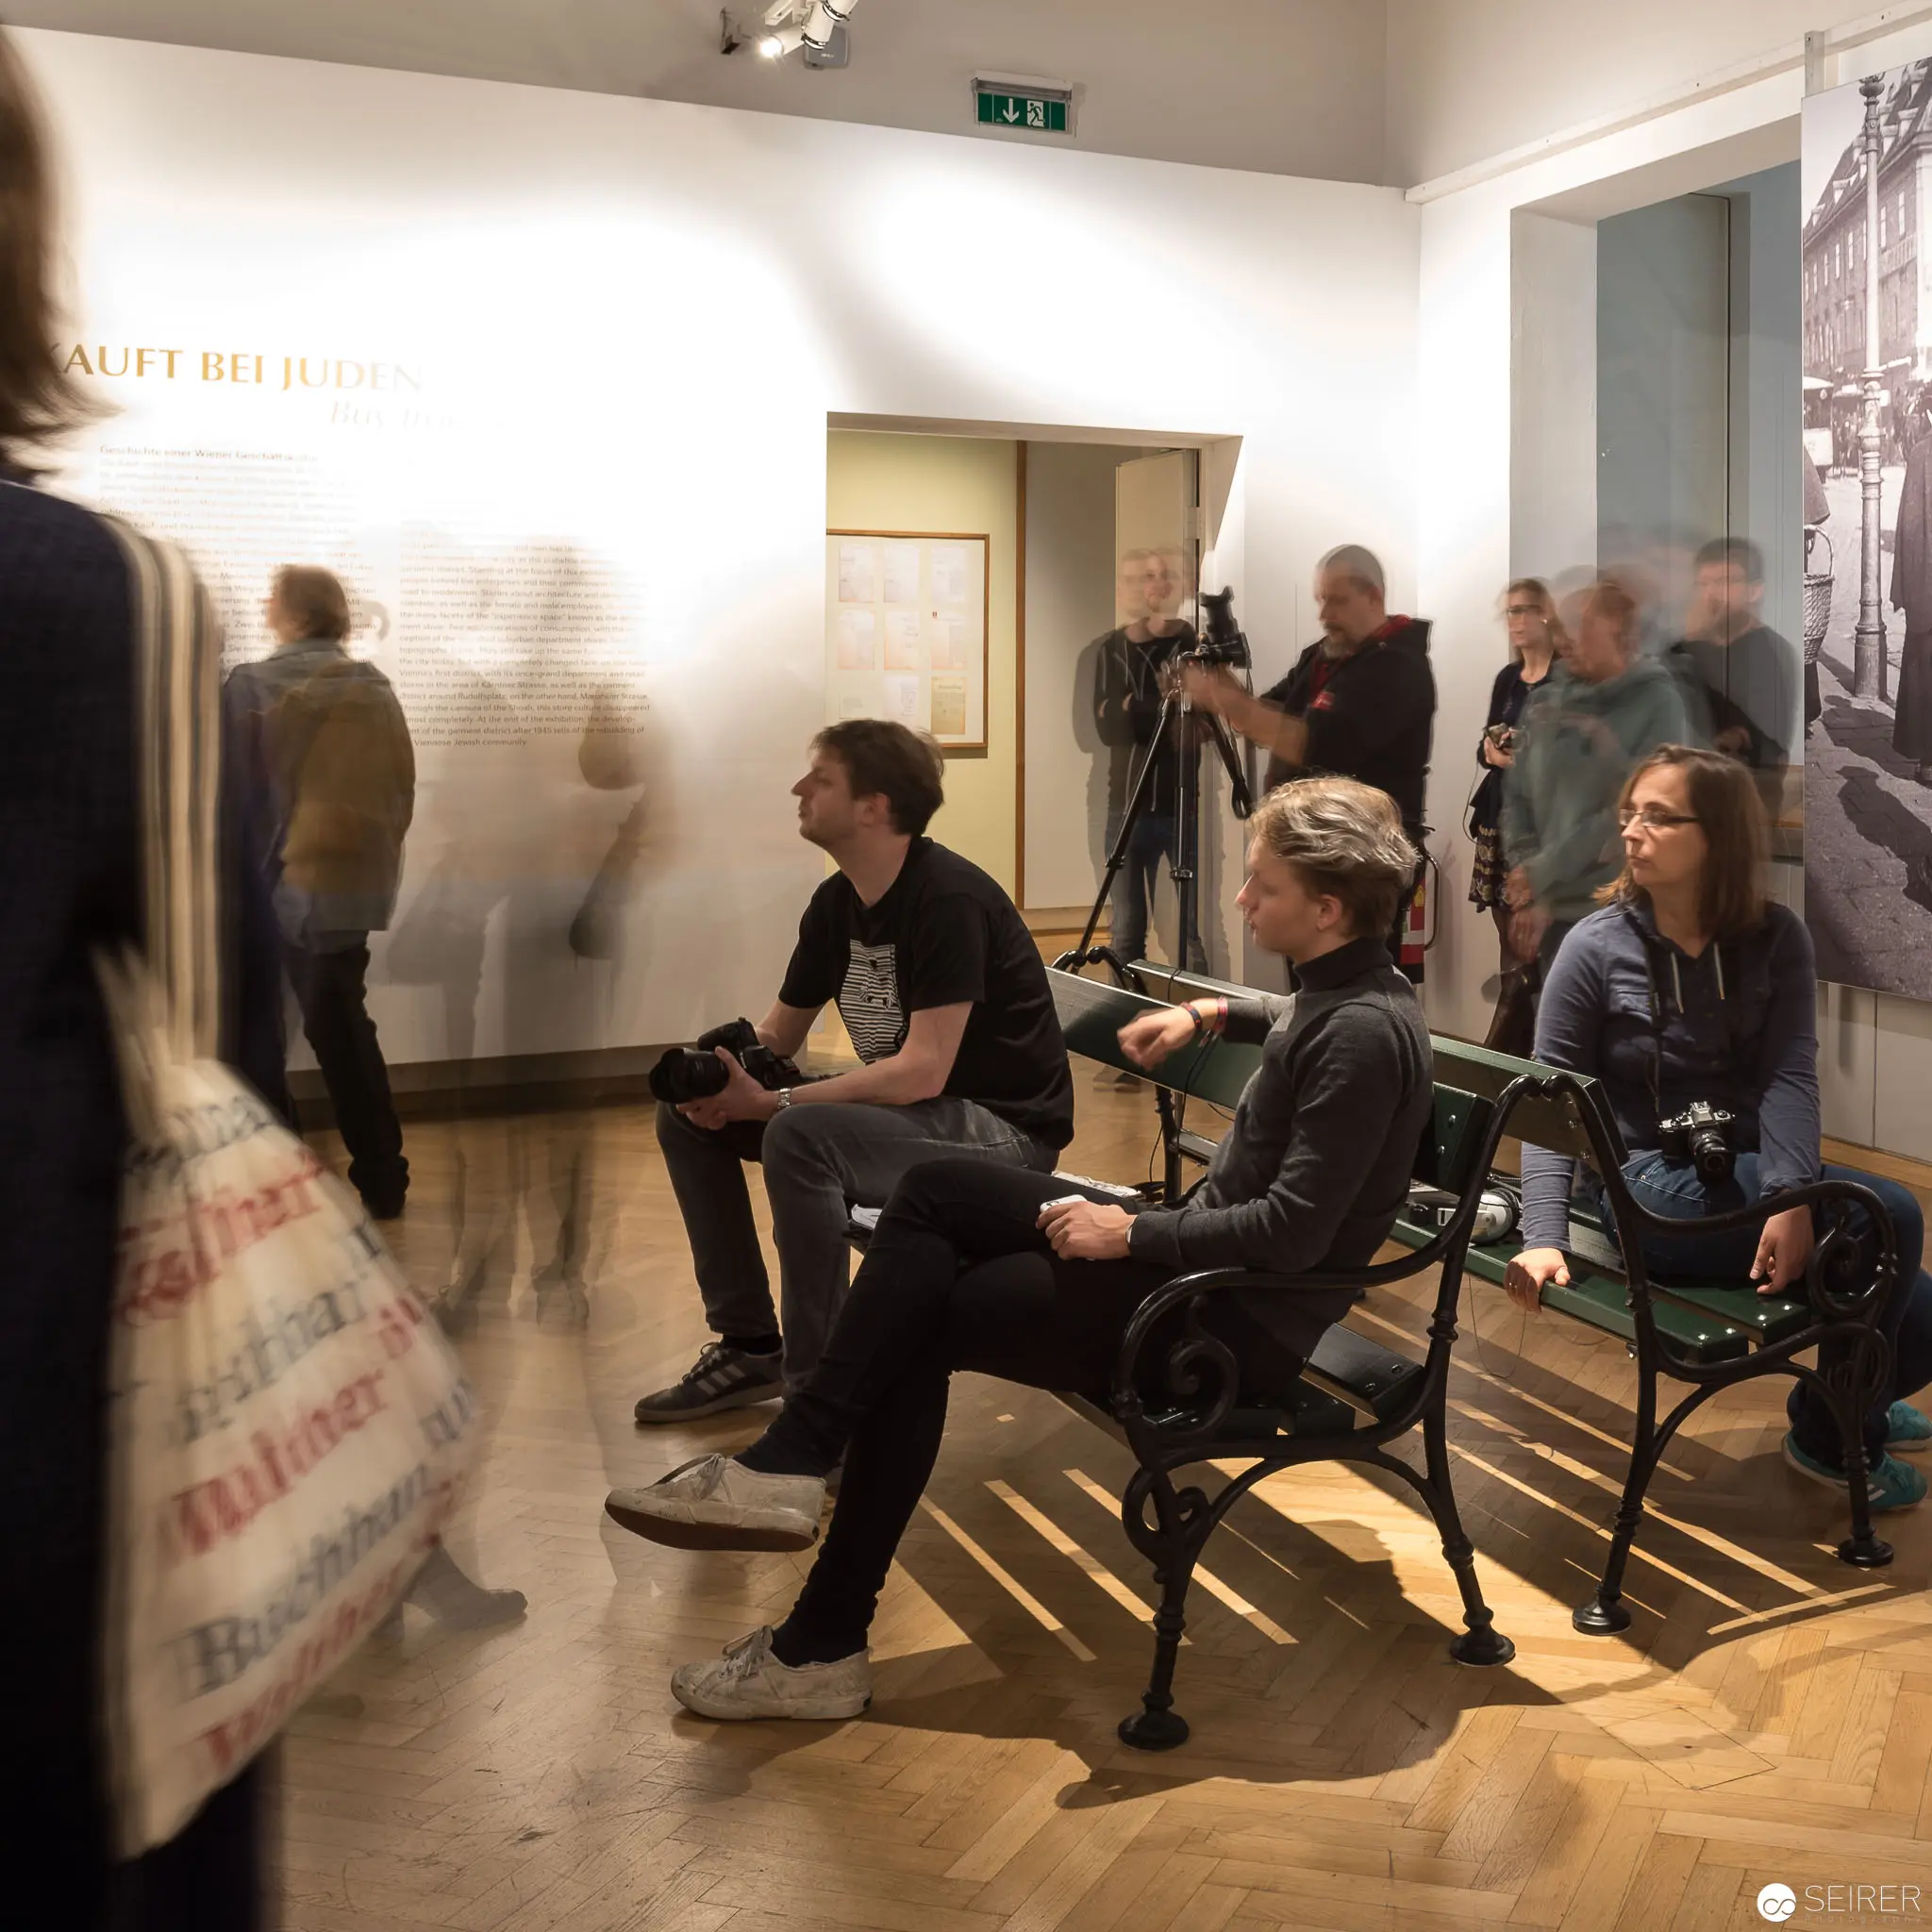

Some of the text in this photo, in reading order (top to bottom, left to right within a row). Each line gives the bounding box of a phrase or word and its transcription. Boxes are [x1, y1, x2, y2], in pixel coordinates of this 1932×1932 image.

[201, 352, 263, 383] BEI
[282, 357, 423, 391] JUDEN
[163, 449, 192, 458] einer
[194, 449, 233, 458] Wiener
[533, 725, 551, 734] 1945
